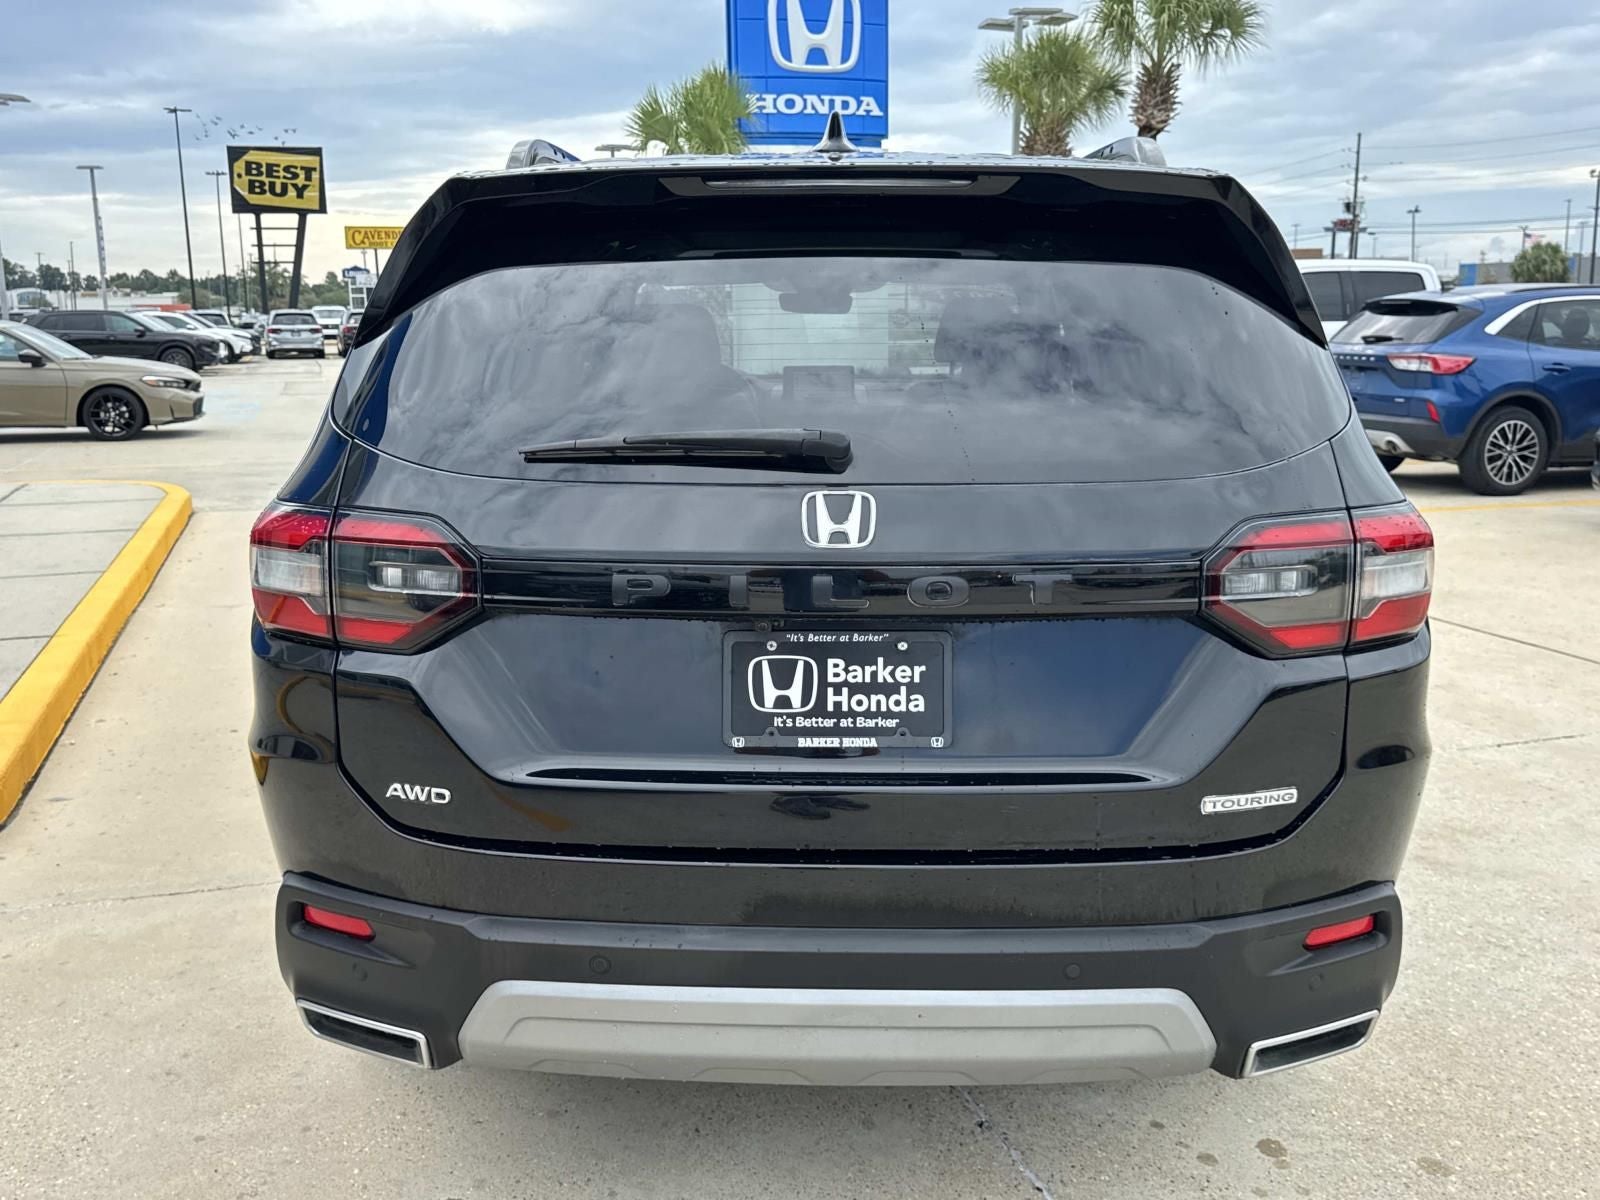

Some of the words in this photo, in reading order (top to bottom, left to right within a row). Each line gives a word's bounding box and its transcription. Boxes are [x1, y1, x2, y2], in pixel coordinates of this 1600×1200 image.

[746, 94, 883, 116] HONDA
[244, 161, 317, 182] BEST
[248, 179, 311, 199] BUY
[612, 574, 1072, 607] PILOT
[808, 633, 836, 642] Better
[840, 634, 849, 642] at
[827, 657, 926, 683] Barker
[827, 686, 925, 712] Honda
[774, 716, 793, 727] It's
[795, 717, 837, 727] Better
[840, 717, 854, 727] at
[856, 717, 899, 728] Barker
[798, 737, 840, 748] BARKER
[842, 737, 878, 748] HONDA
[386, 783, 451, 803] AWD
[1208, 792, 1295, 809] TOURING
